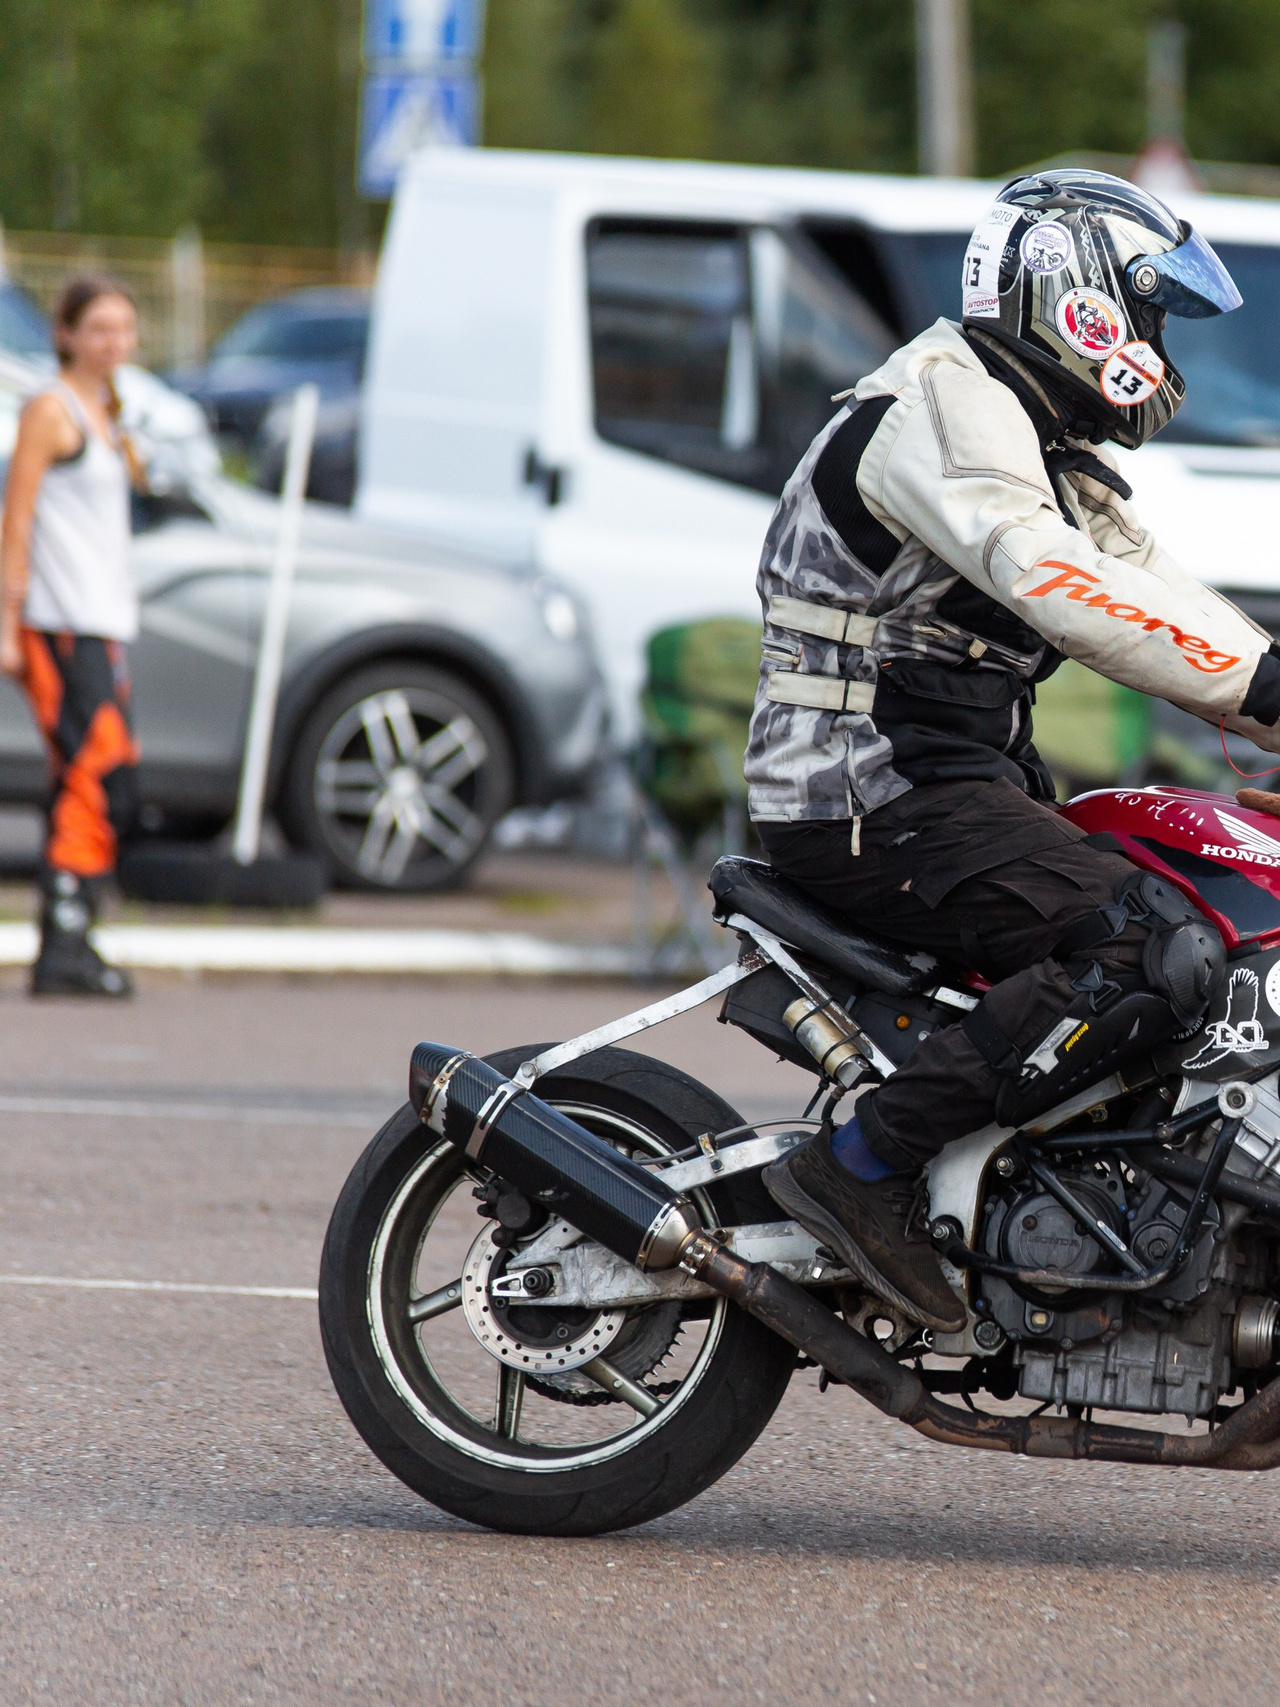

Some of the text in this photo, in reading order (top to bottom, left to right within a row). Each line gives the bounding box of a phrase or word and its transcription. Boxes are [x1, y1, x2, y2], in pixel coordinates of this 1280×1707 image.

[965, 256, 982, 287] 13
[1110, 368, 1144, 396] 13
[1027, 1235, 1080, 1247] HONDA
